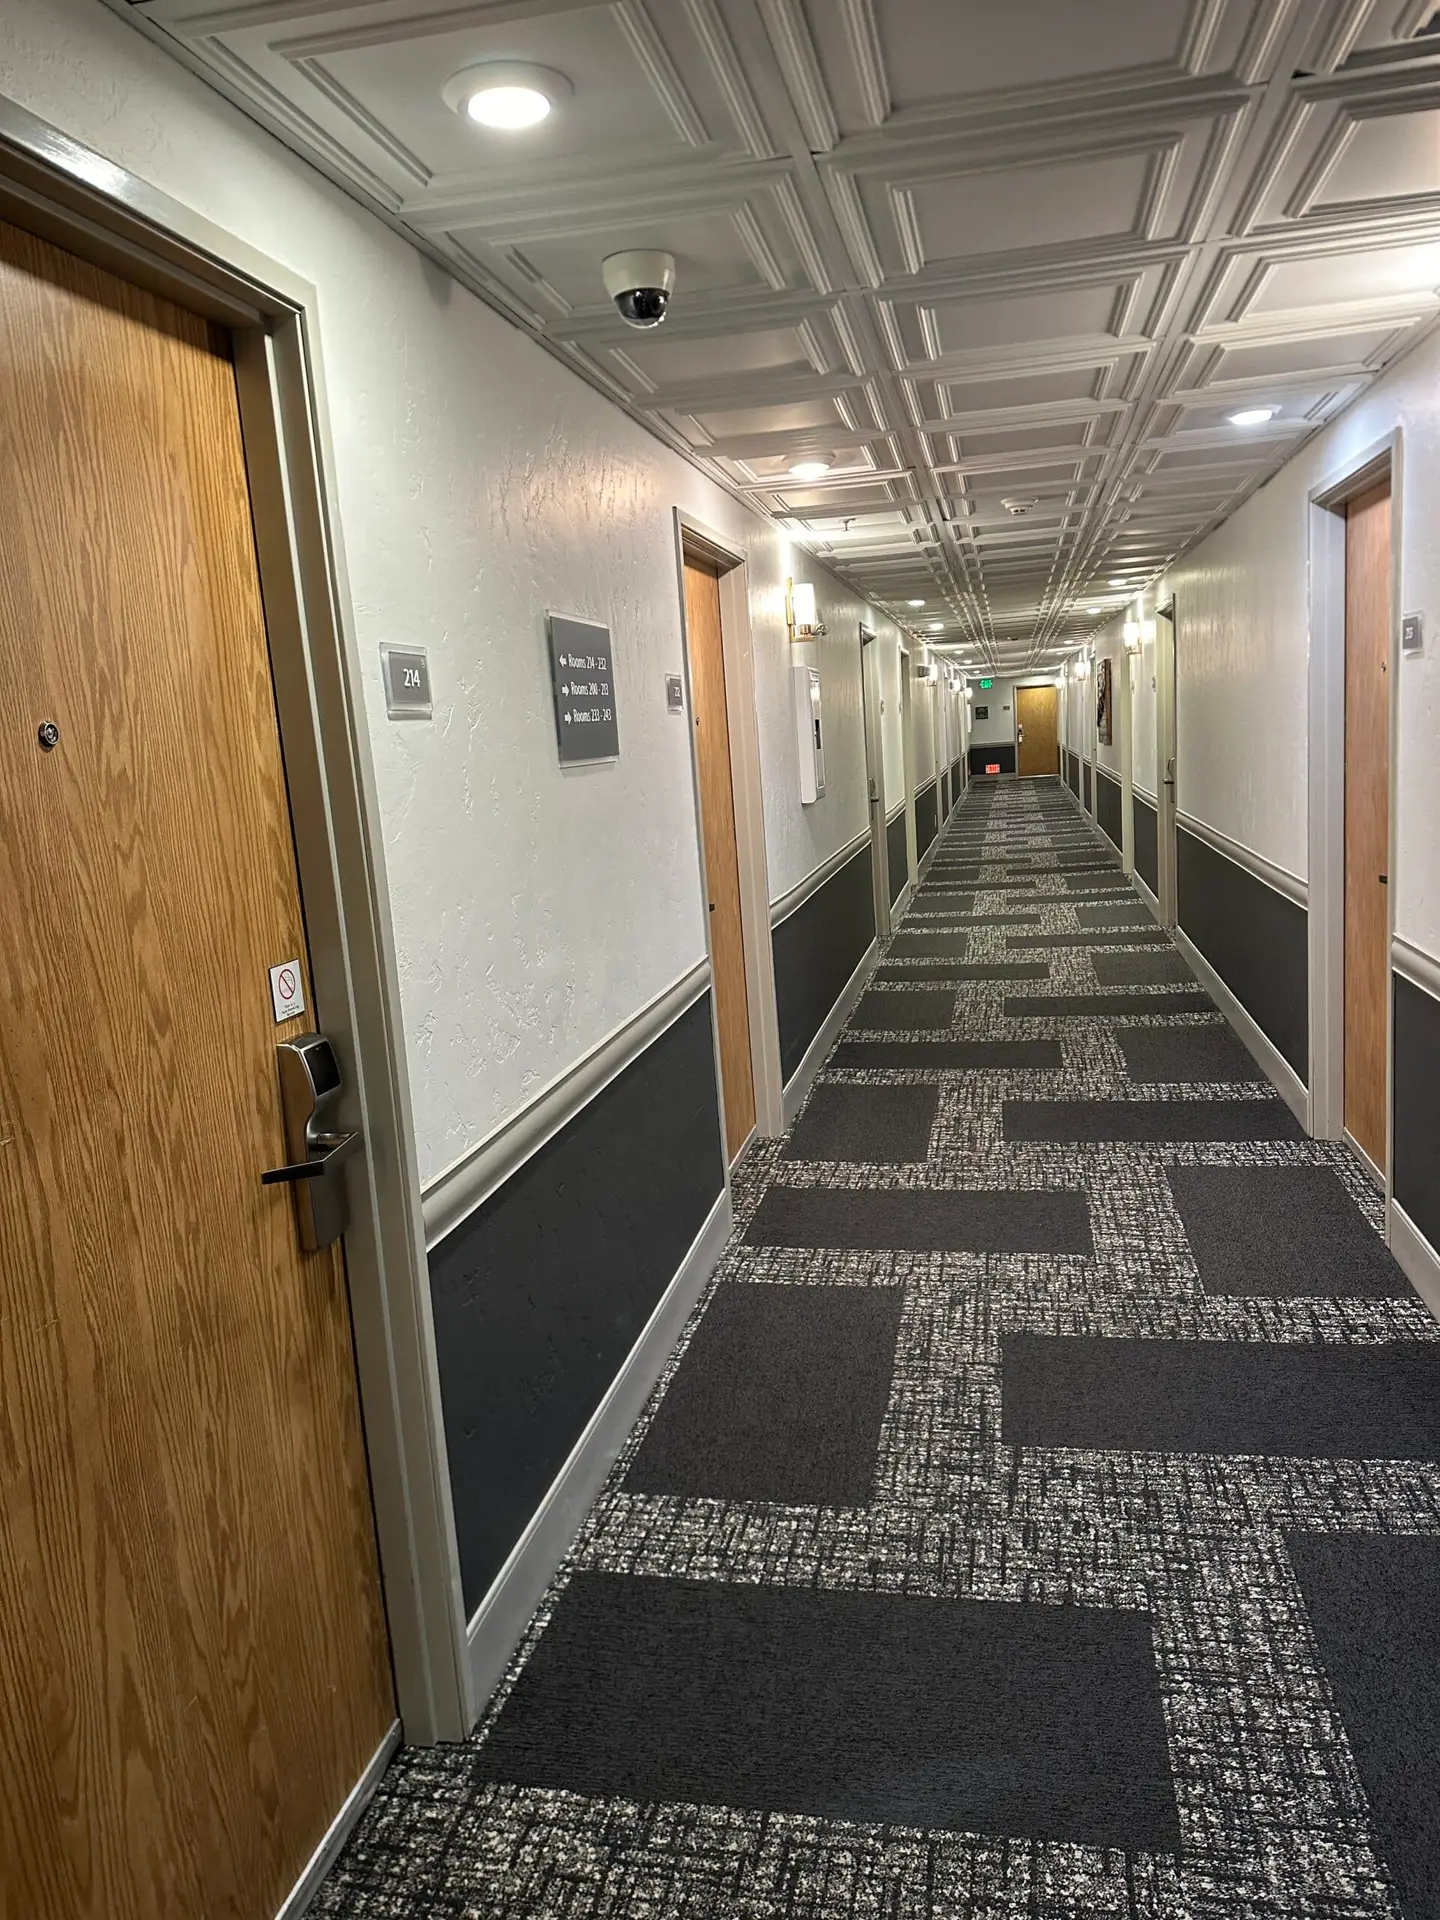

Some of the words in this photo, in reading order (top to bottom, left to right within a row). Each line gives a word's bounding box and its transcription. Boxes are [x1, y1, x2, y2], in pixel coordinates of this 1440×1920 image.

[568, 653, 586, 669] Rooms
[586, 655, 595, 669] 214
[403, 668, 420, 687] 214
[571, 681, 588, 695] Rooms
[588, 682, 598, 695] 200
[573, 708, 590, 722] Rooms
